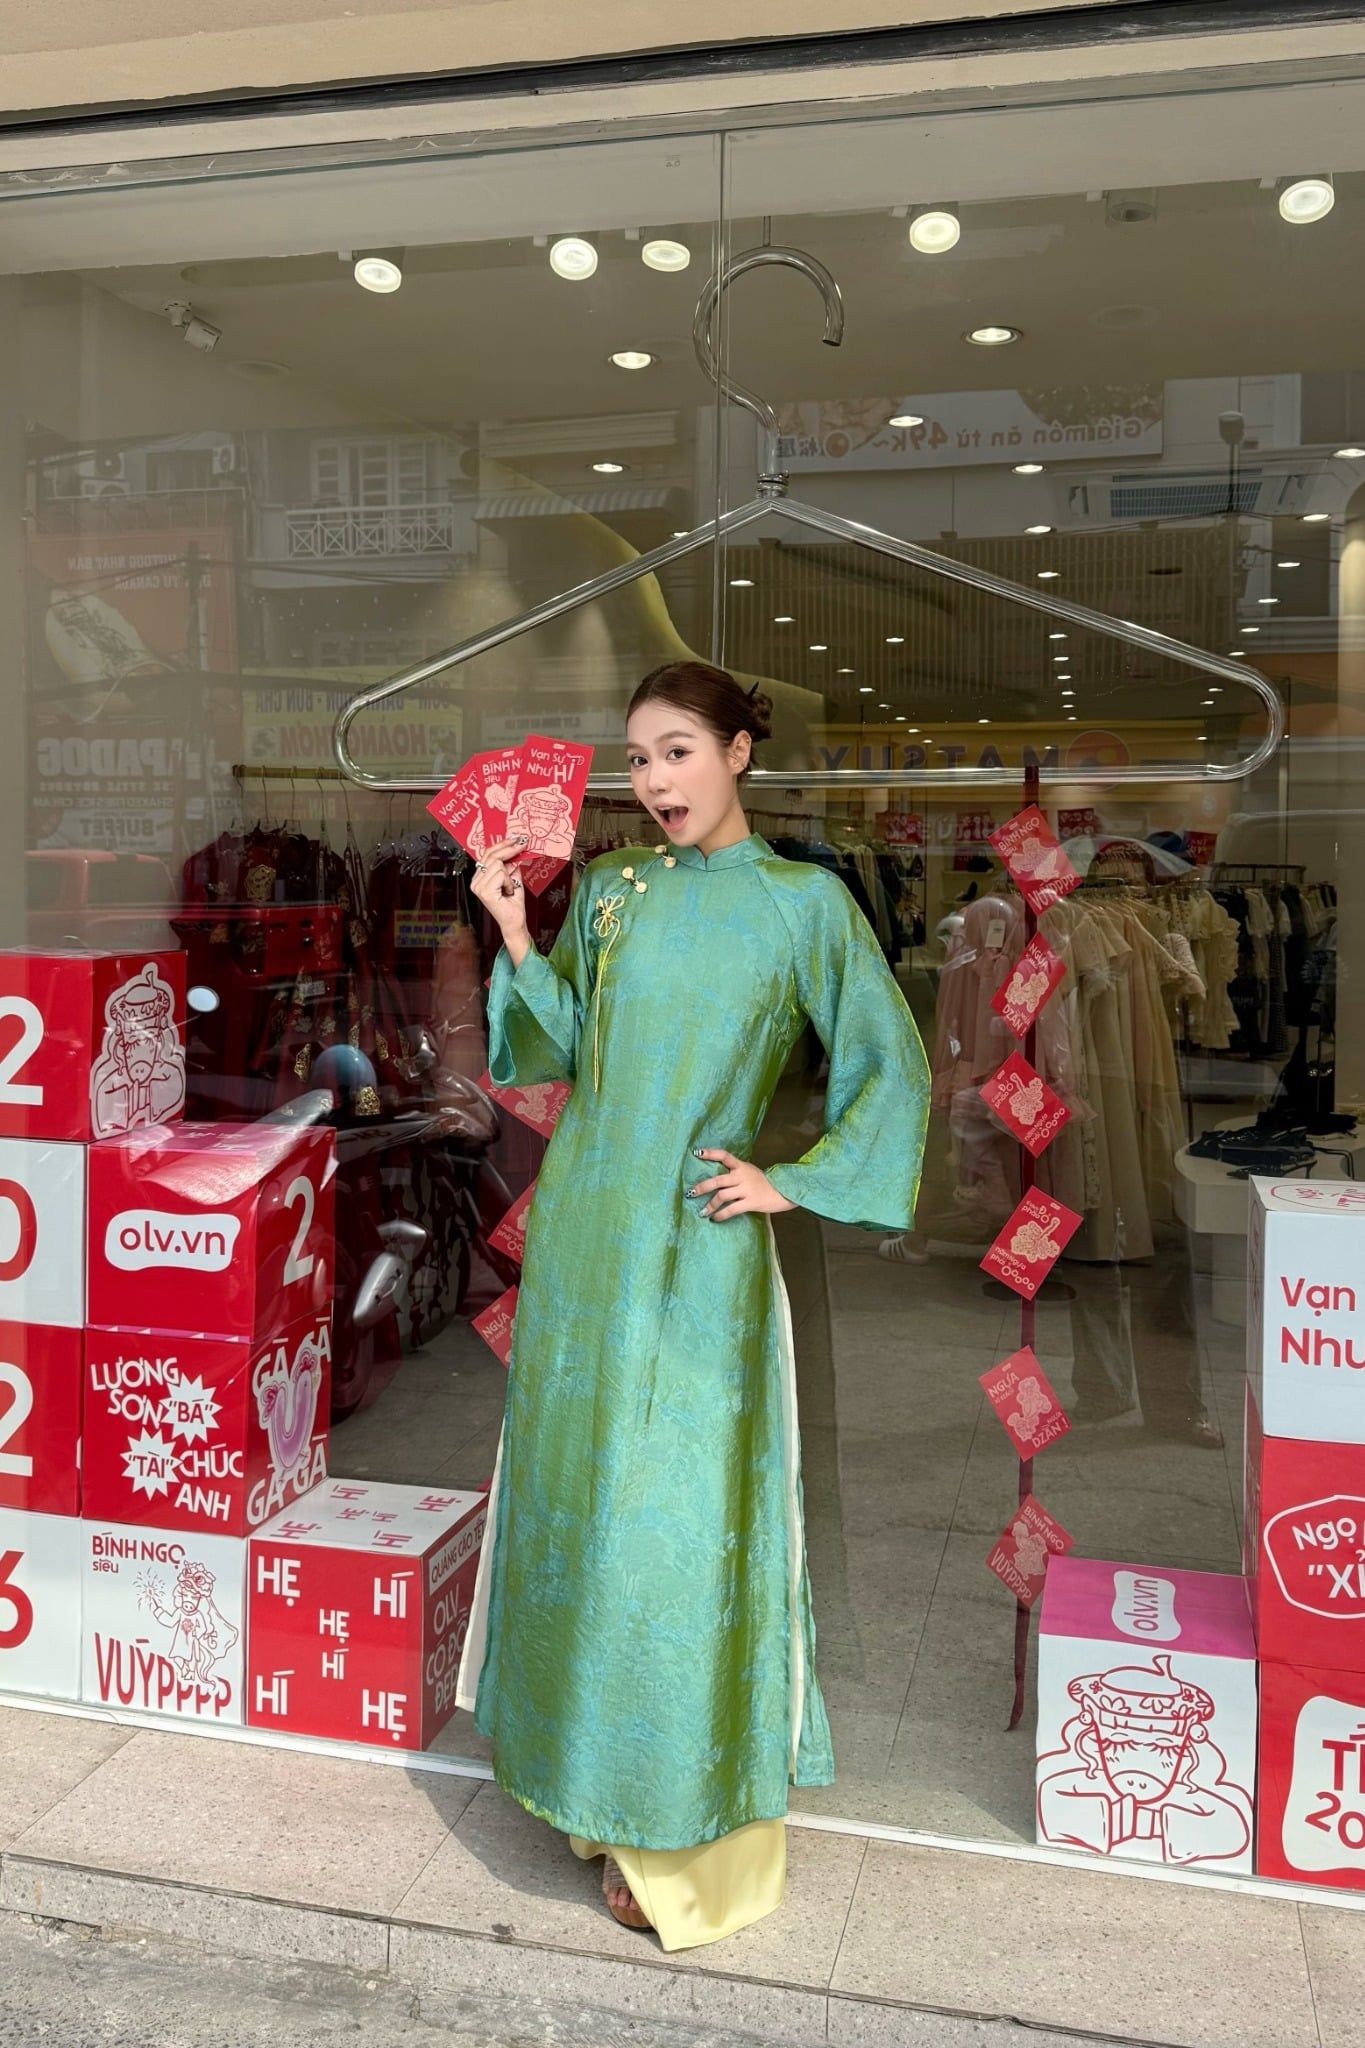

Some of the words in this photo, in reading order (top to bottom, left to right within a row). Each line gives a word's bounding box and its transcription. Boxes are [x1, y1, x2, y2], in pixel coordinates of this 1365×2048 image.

[526, 762, 553, 777] Như
[530, 748, 550, 762] Vạn
[119, 1220, 228, 1257] olv.vn
[283, 1175, 315, 1287] 2
[1280, 1276, 1356, 1317] Vạn
[90, 1355, 179, 1391] LƯƠNG
[107, 1388, 164, 1430] SƠN
[179, 1442, 244, 1478] CHÚC
[174, 1482, 231, 1521] ANH
[92, 1531, 137, 1561] BÍNH
[140, 1541, 186, 1570] NGỌ
[1291, 1516, 1357, 1551] Ngọ
[257, 1555, 301, 1608] HẸ
[373, 1571, 415, 1619] HÍ
[1132, 1577, 1159, 1633] olv.vn
[319, 1608, 350, 1644] HẸ
[433, 1583, 460, 1636] OLV
[321, 1647, 350, 1681] HÍ
[256, 1669, 296, 1716] HÍ
[361, 1688, 408, 1742] HẸ
[1322, 1722, 1365, 1794] T
